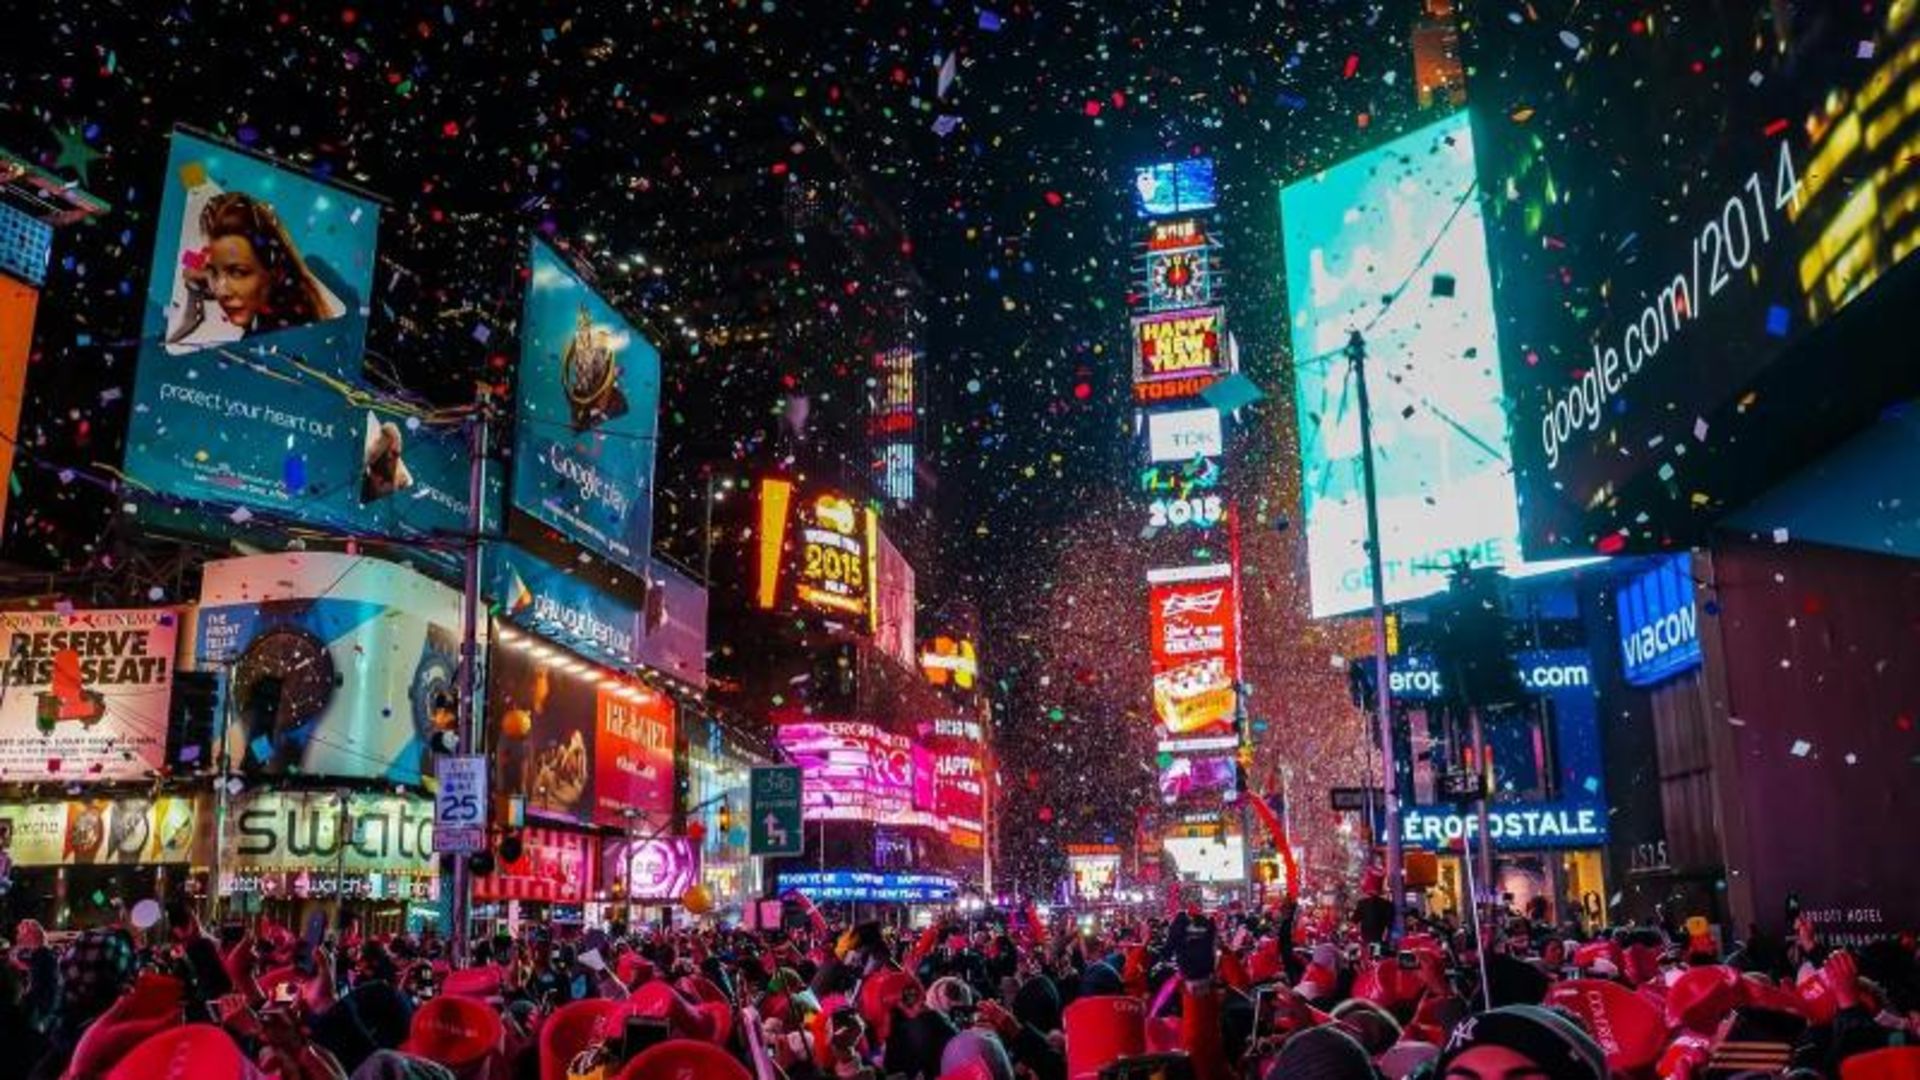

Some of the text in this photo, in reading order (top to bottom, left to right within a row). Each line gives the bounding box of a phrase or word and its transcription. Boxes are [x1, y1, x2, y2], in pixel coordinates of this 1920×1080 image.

[1541, 139, 1801, 469] google.com/2014
[1155, 334, 1205, 357] NEW
[1136, 376, 1214, 400] TOSHIB
[160, 383, 335, 439] protect your heart out
[551, 440, 602, 500] Google
[804, 544, 863, 587] 2015
[10, 630, 150, 659] RESERVE
[81, 657, 167, 684] SEAT!
[441, 795, 478, 821] 25
[238, 801, 433, 862] swatc
[1383, 810, 1597, 842] ÉROPOSTALE
